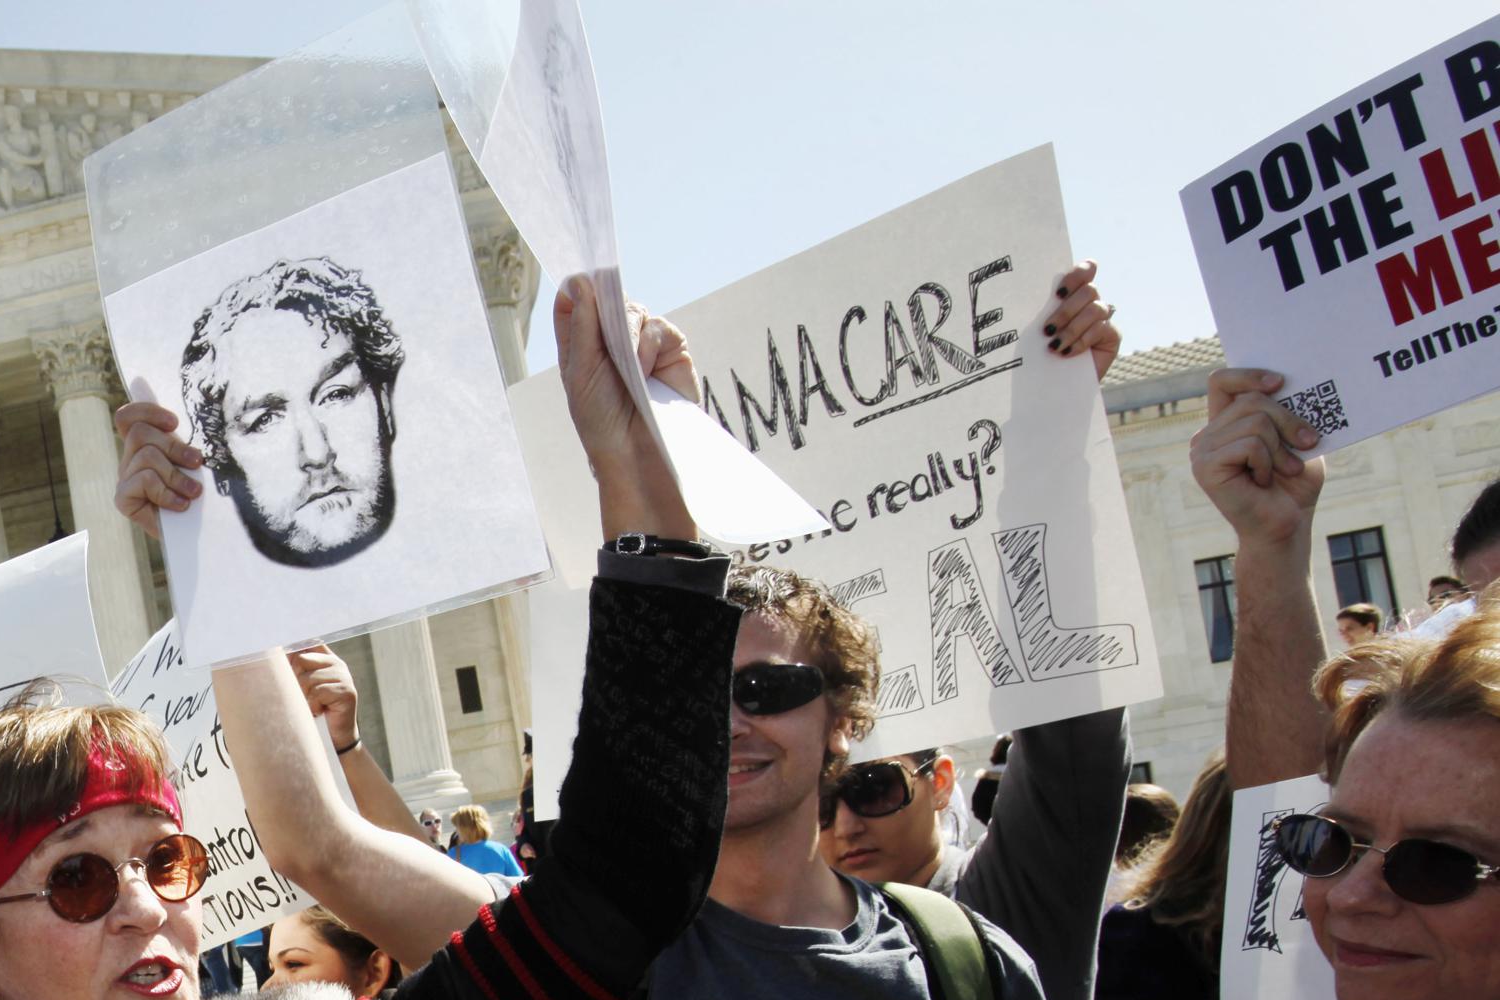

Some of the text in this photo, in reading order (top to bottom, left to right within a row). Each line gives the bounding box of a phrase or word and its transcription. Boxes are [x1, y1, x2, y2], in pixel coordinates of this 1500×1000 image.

[1211, 72, 1427, 245] DON'T
[1259, 119, 1500, 292] THE LI
[1375, 213, 1500, 327] ME
[1373, 304, 1500, 378] TellThe
[866, 418, 1002, 530] really?
[202, 866, 297, 940] TIONS!!
